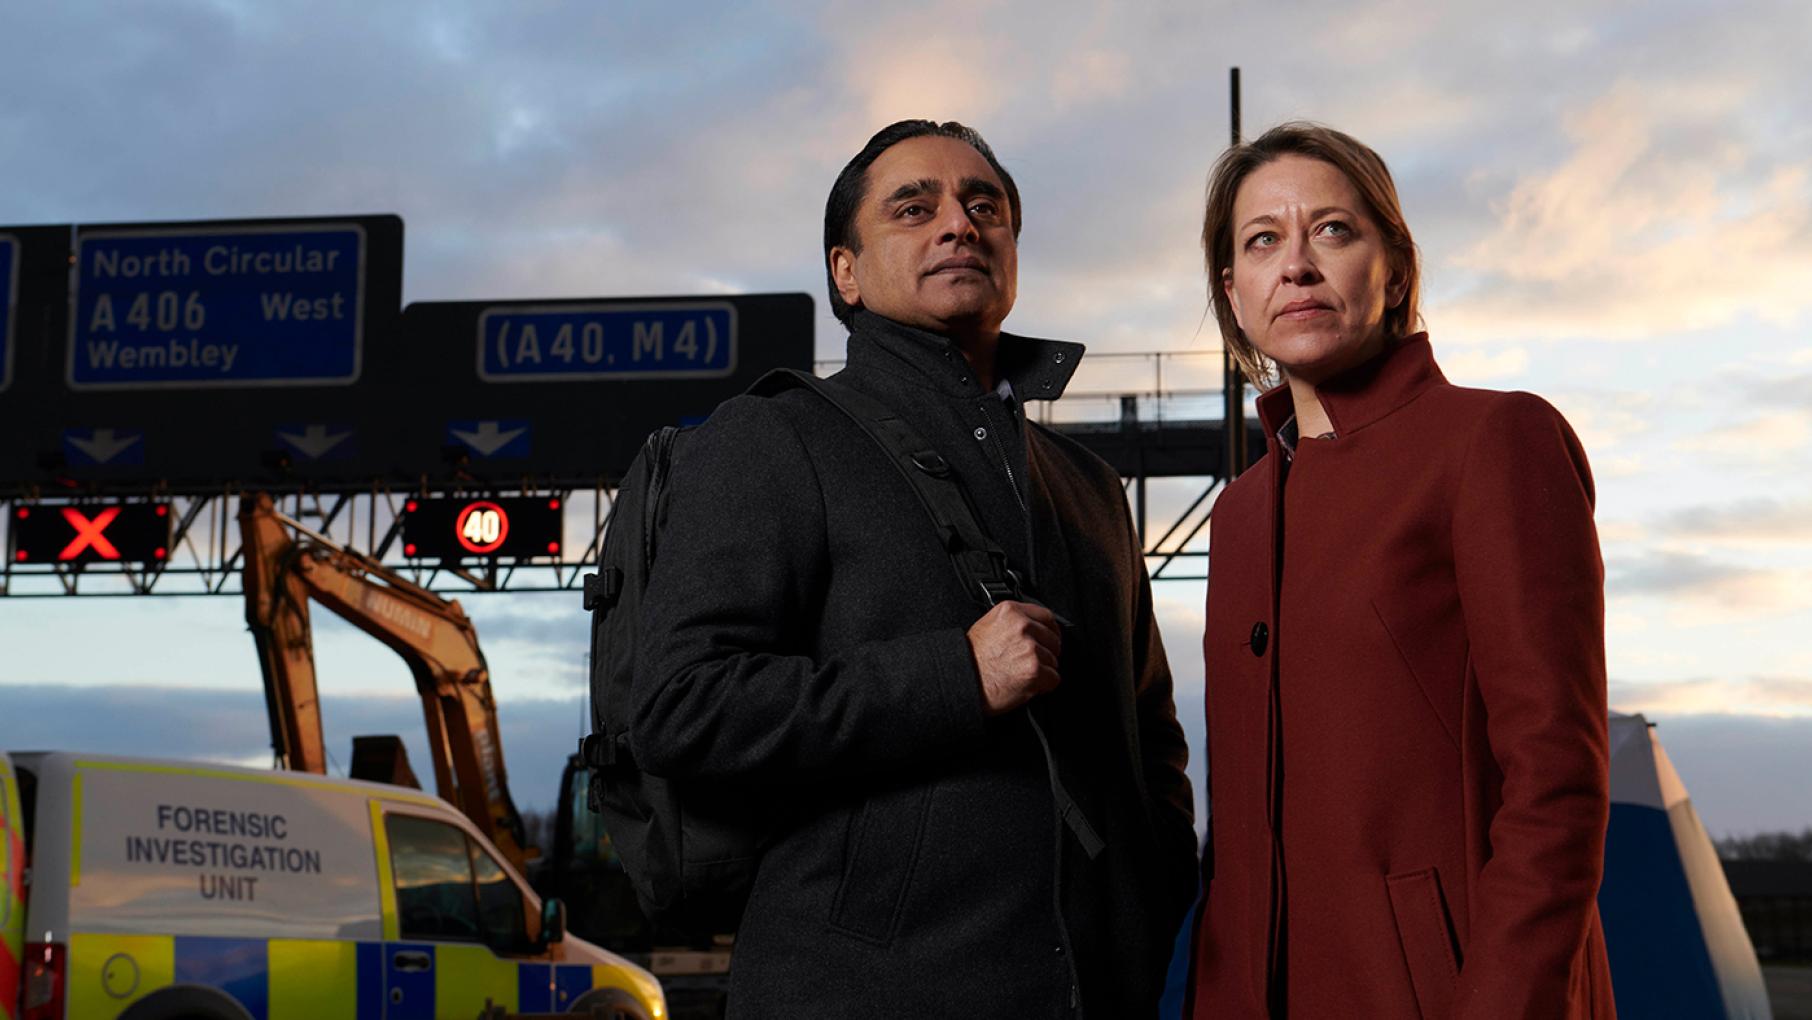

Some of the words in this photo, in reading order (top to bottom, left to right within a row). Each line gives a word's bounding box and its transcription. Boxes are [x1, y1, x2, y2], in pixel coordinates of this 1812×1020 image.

[93, 249, 191, 278] North
[204, 246, 339, 275] Circular
[261, 293, 344, 321] West
[88, 340, 238, 372] Wembley
[462, 510, 500, 543] 40
[157, 805, 287, 839] FORENSIC
[126, 836, 321, 874] INVESTIGATION
[199, 874, 258, 902] UNIT
